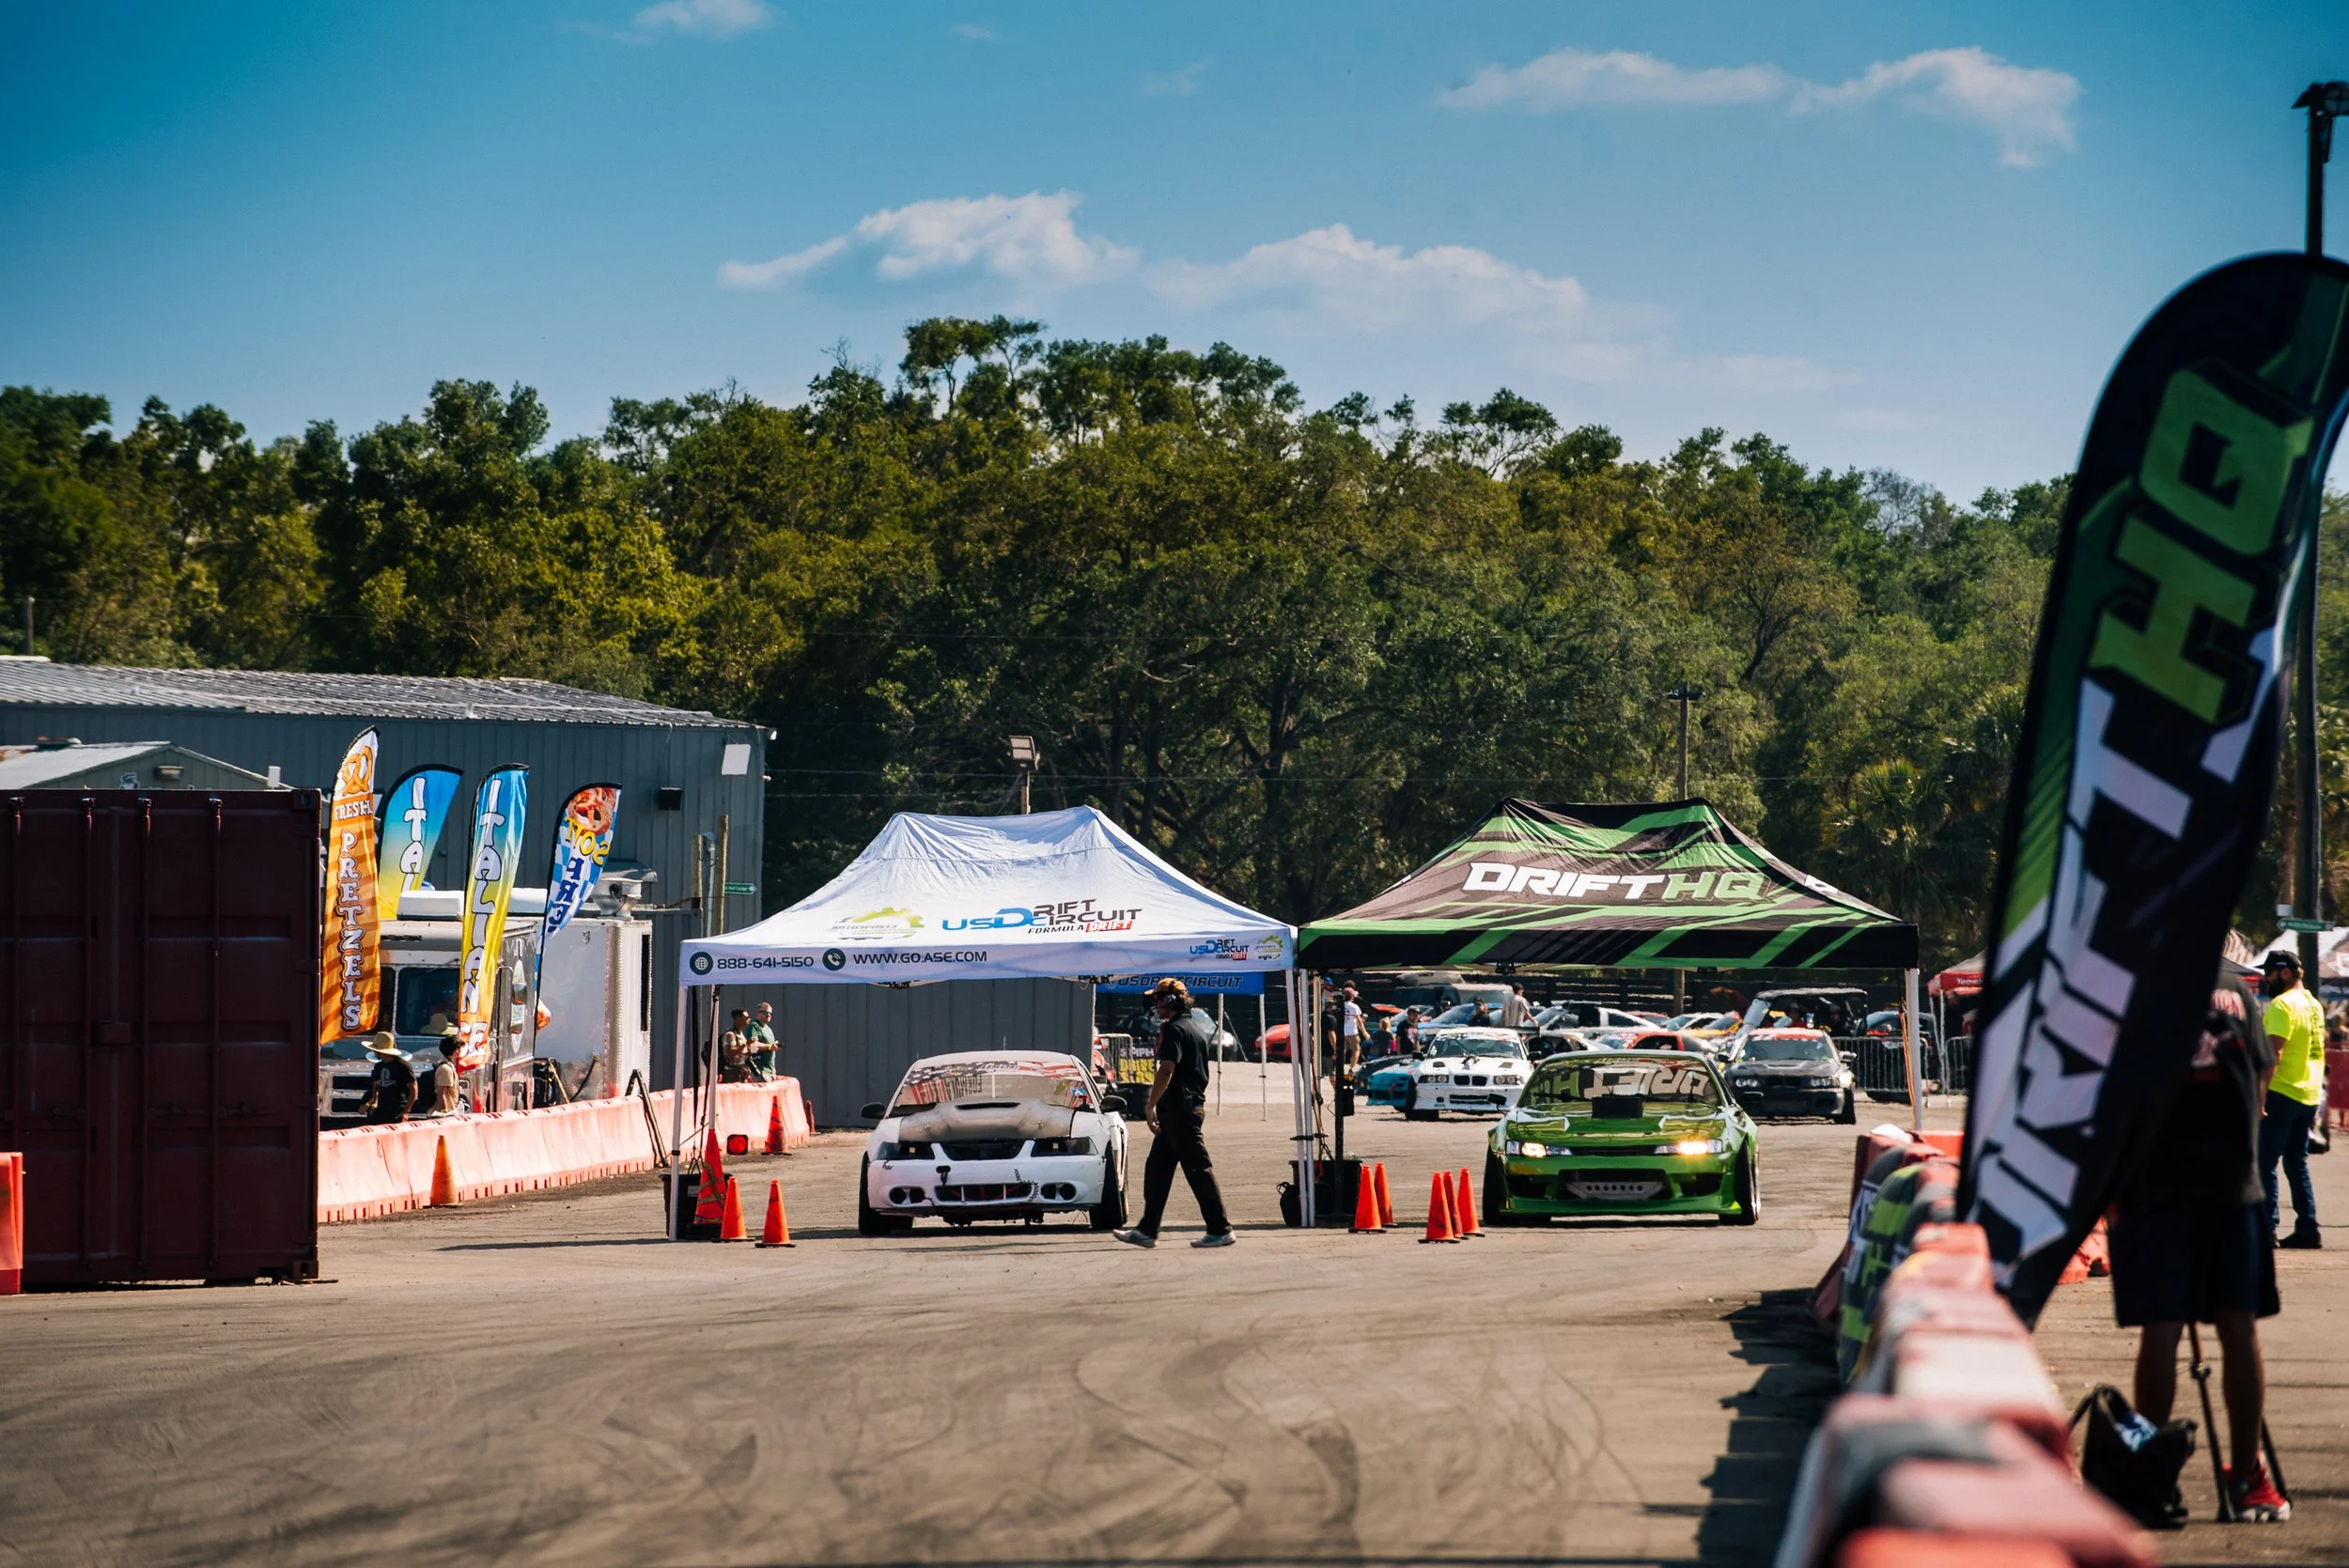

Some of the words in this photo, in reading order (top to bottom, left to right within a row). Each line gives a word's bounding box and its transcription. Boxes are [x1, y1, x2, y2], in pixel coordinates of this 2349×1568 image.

[334, 800, 374, 821] FRESH
[461, 778, 506, 1015] ITALIAN
[1033, 908, 1143, 926] CIRCUIT
[338, 830, 365, 1030] PRETZELS
[1027, 924, 1084, 935] FORMULA
[1085, 921, 1133, 933] DRIFT
[717, 955, 815, 970] 888-641-5150
[853, 951, 988, 965] WWW.GO.ASE.COM
